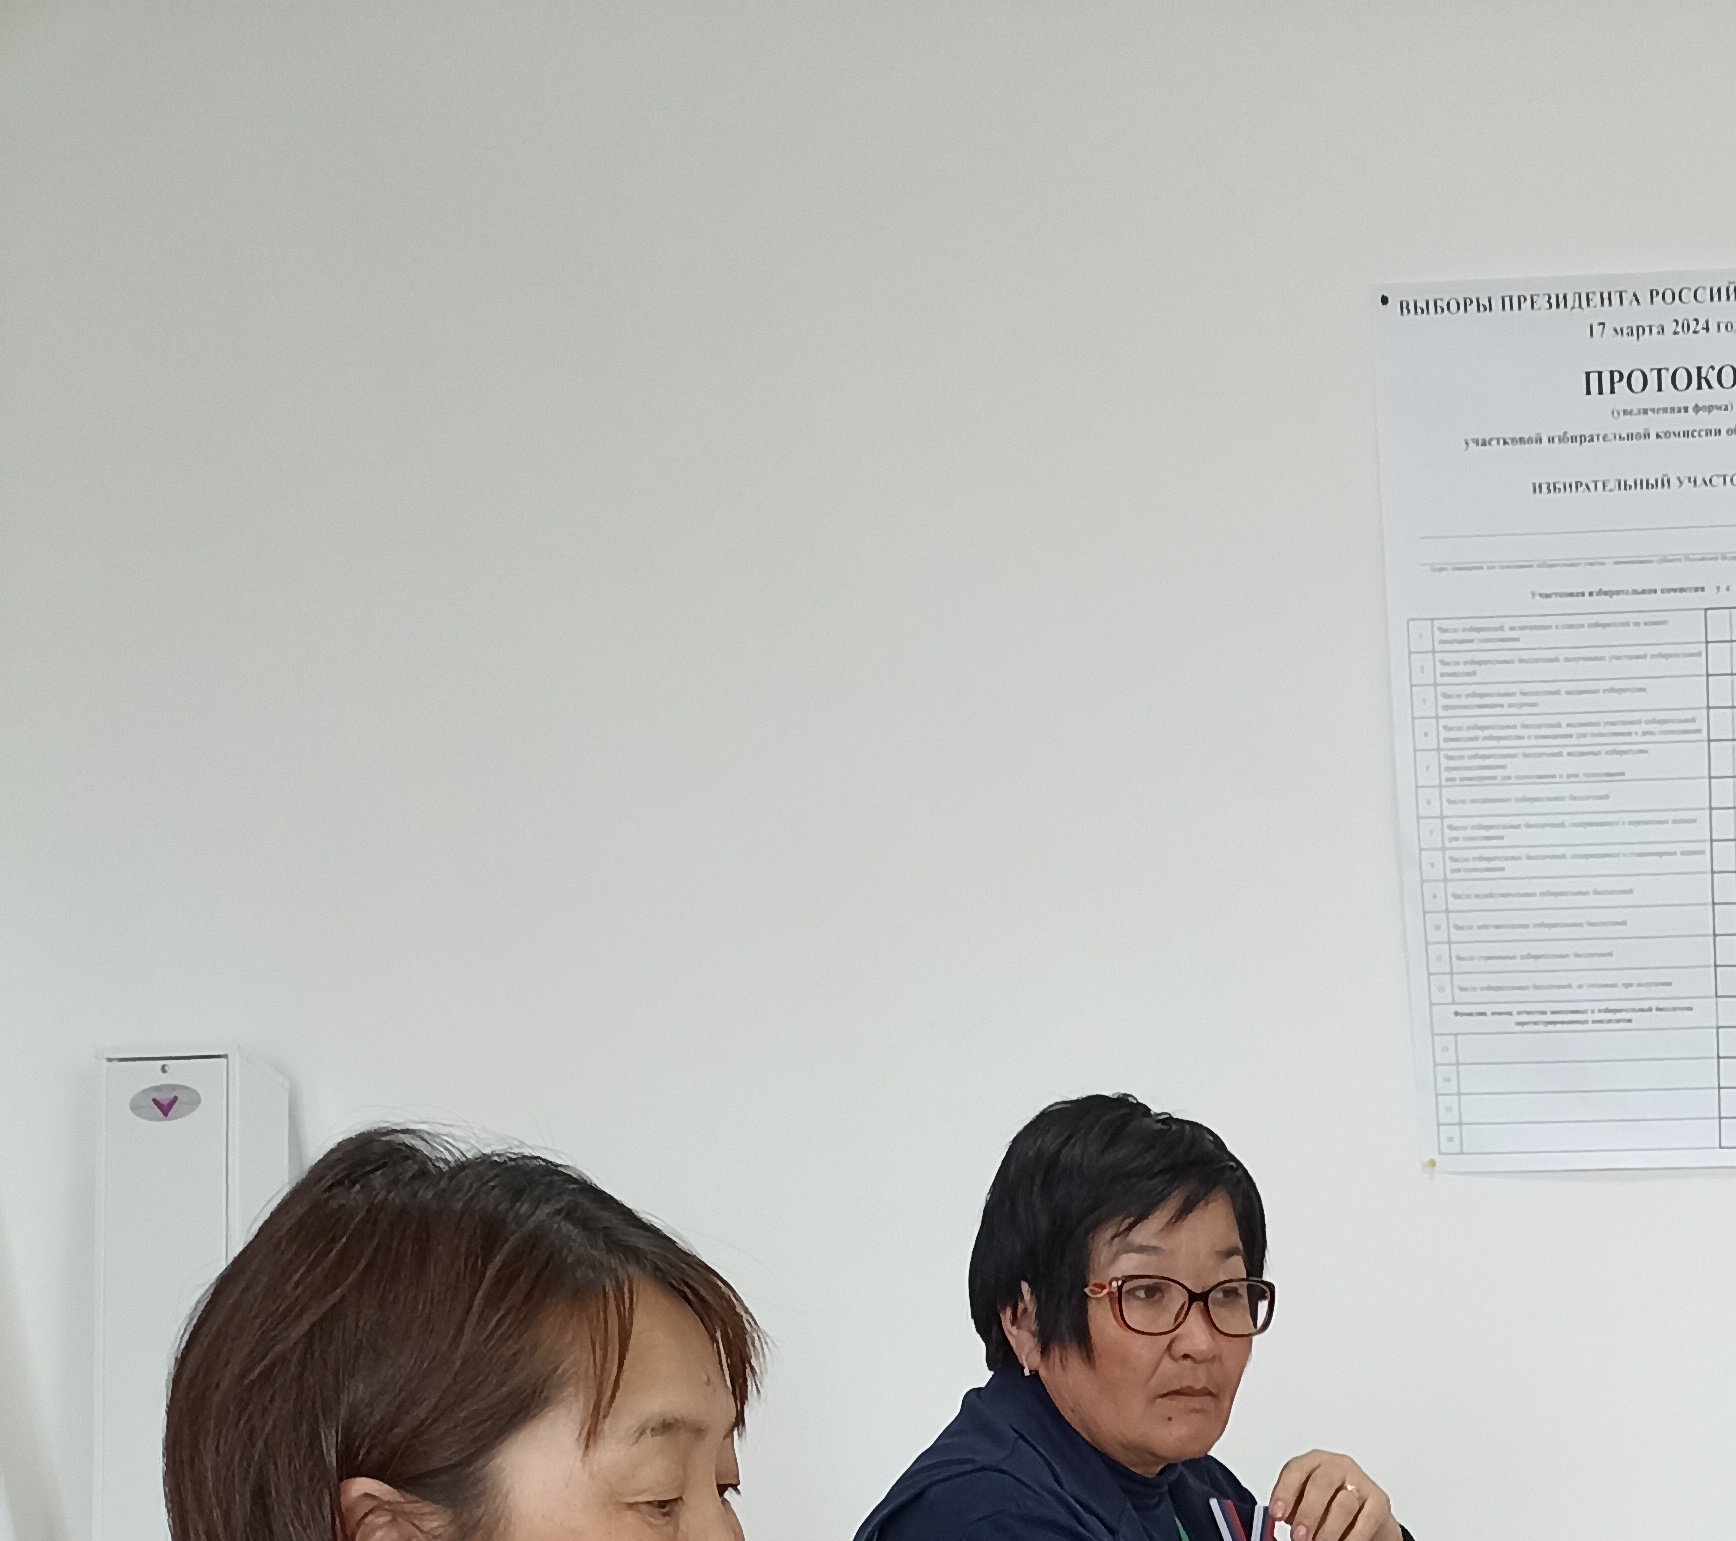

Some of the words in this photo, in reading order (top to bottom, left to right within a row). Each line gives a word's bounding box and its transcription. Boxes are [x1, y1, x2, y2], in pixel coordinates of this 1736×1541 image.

[1398, 294, 1493, 316] ВЫБОРЫ
[1500, 288, 1642, 313] ПРЕЗИДЕНТА
[1588, 321, 1607, 340] 17
[1612, 322, 1666, 342] марта
[1671, 317, 1711, 336] 2024
[1463, 432, 1544, 452] участковой
[1547, 427, 1652, 447] избирательной
[1655, 423, 1723, 441] комиссии
[1531, 473, 1672, 496] ИЗБИРАТЕЛЬНЫЙ
